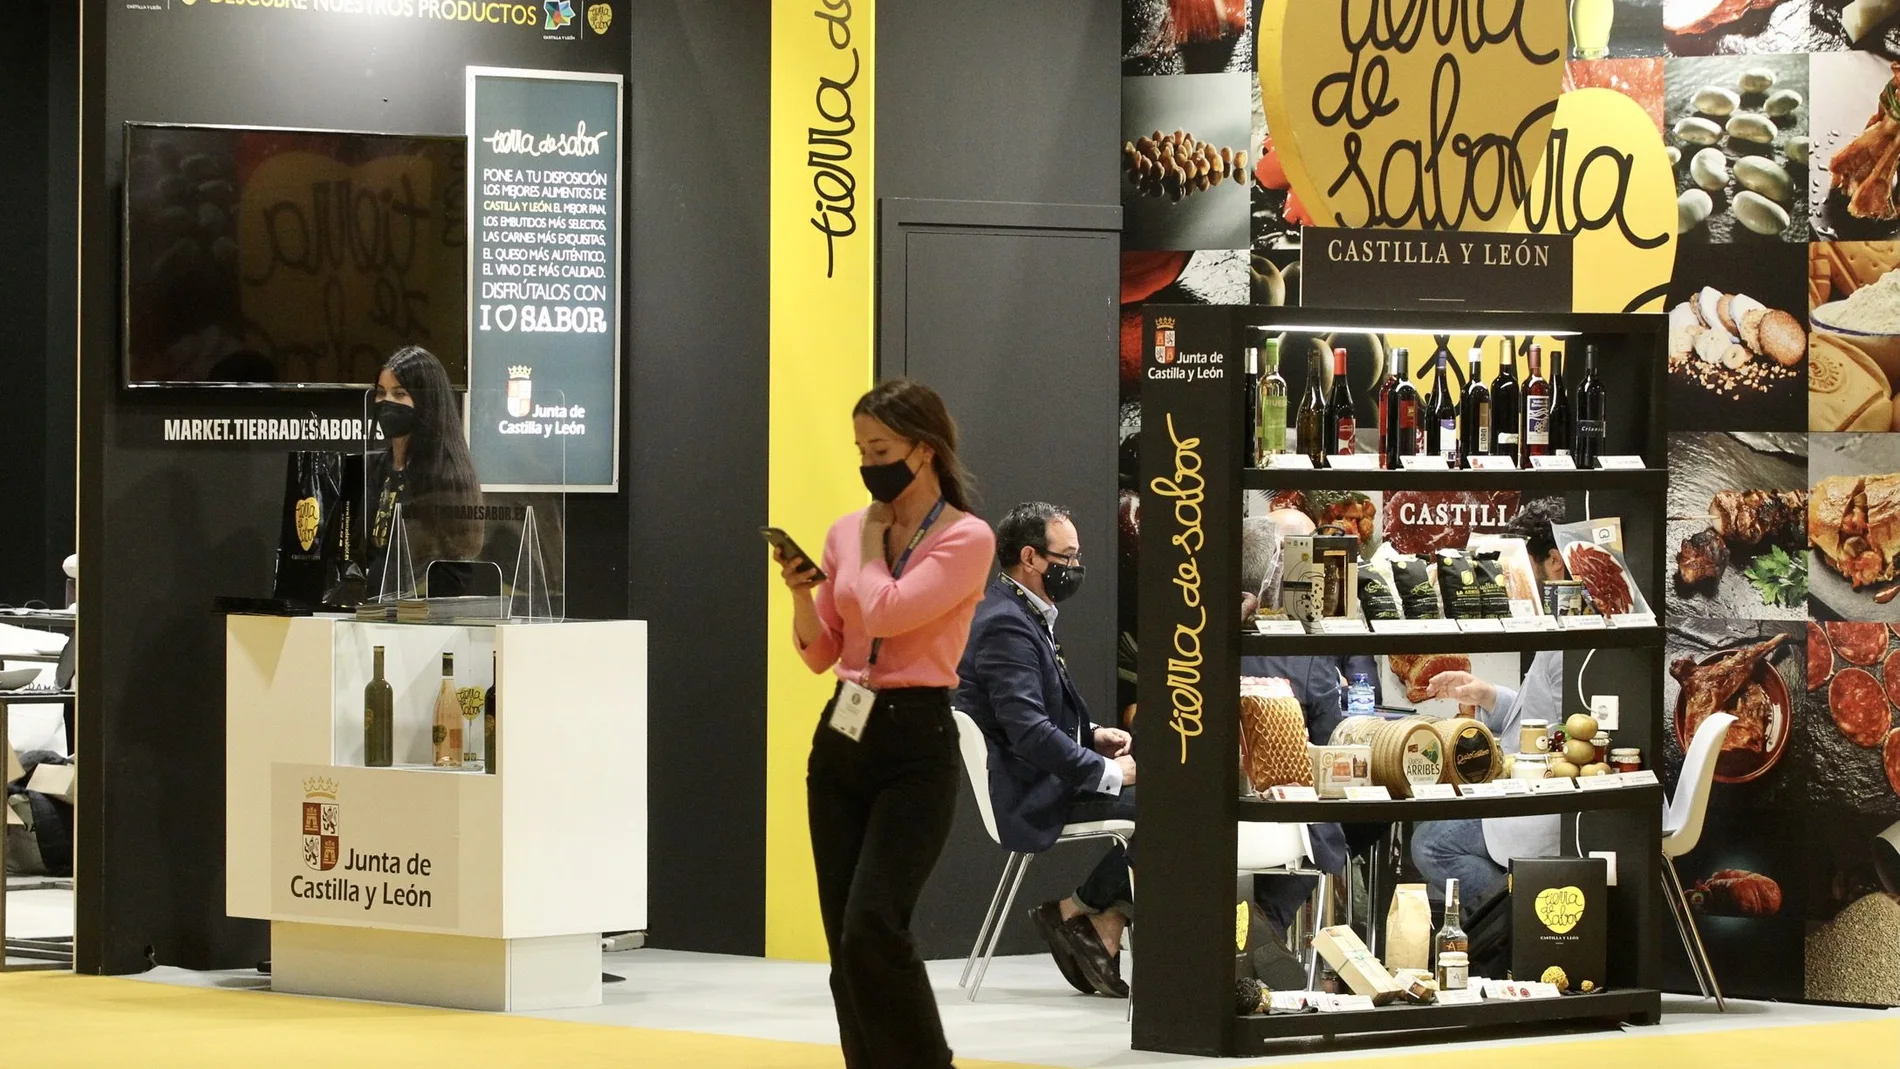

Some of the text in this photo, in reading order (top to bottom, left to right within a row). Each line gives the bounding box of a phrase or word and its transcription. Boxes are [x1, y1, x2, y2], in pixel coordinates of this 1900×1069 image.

[418, 0, 537, 26] PRODUCTOS
[1312, 50, 1400, 130] de
[483, 120, 608, 157] tierra de sabor
[1327, 53, 1562, 231] sabor
[807, 47, 860, 279] tierra
[483, 168, 608, 186] PONE A TU DISPOSICIÓN
[483, 184, 607, 200] LOS MEJORES ALIMENTOS DE
[483, 201, 520, 211] CASTILLA
[521, 202, 528, 211] Y
[554, 203, 563, 213] EL
[564, 203, 588, 215] MEJOR
[483, 216, 607, 231] LOS EMBUTIDOS MÁS SELECTOS,
[483, 231, 606, 246] LAS CARNES MÁS EXQUISITAS,
[483, 247, 606, 263] EL QUESO MÁS AUTÉNTICO,
[1328, 238, 1550, 267] CASTILLA Y LEÓN
[482, 262, 606, 278] EL VINO DE MÁS CALIDAD.
[482, 279, 607, 301] DISFRÚTALOS CON
[479, 304, 607, 333] I SABOR
[1177, 351, 1223, 364] Junta de
[1147, 366, 1223, 382] Castilla y León
[532, 404, 585, 418] Junta de
[164, 419, 384, 441] MARKET.TIERRADESABOR.S
[498, 420, 585, 438] Castilla y León
[1150, 412, 1206, 764] tierra de sabor
[1407, 763, 1440, 776] ARRIBES
[344, 848, 432, 876] Junta de
[290, 875, 432, 910] Castilla y León
[1537, 891, 1583, 906] tierra
